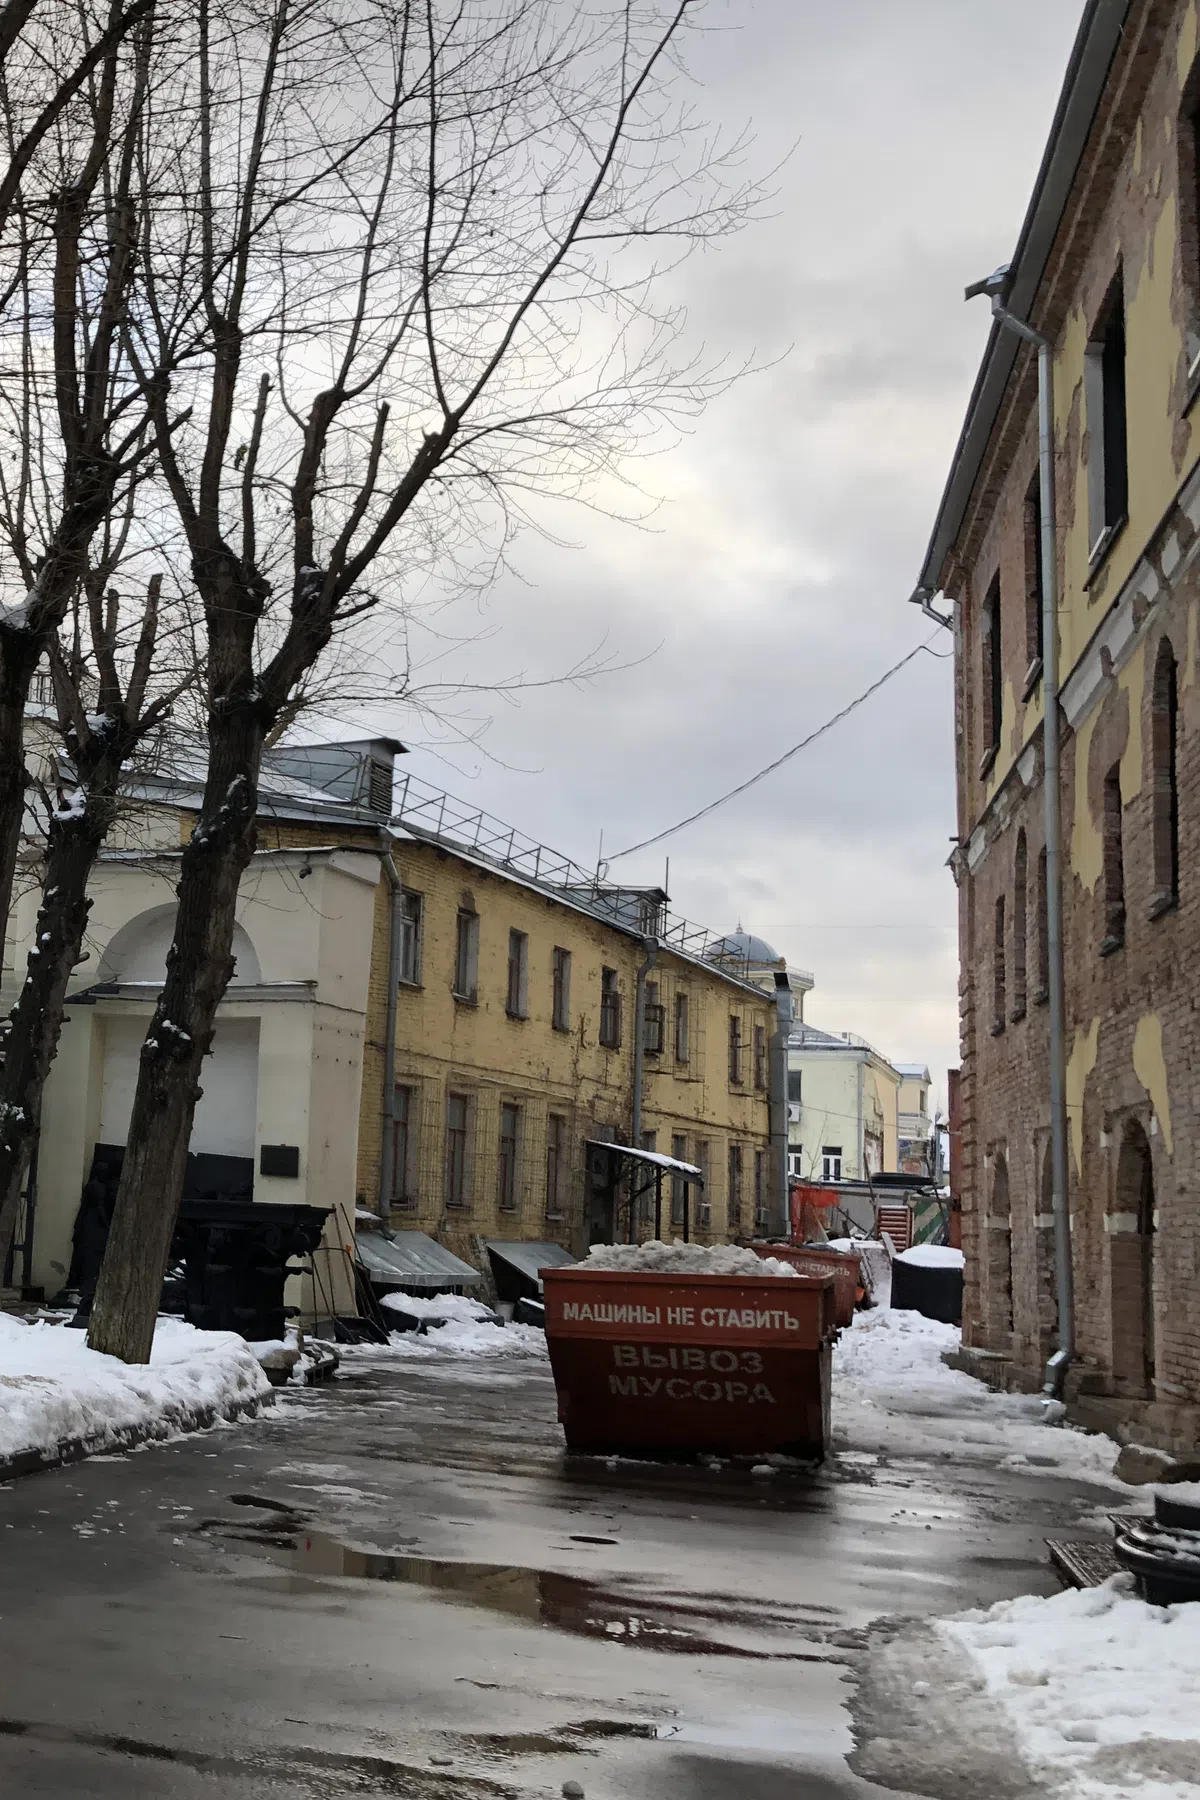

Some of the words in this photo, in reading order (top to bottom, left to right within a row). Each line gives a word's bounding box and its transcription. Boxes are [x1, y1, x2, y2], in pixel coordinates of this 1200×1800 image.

[810, 1263, 850, 1276] СТАВИТЬ
[563, 1302, 661, 1324] МАШИНЫ
[667, 1306, 695, 1326] НЕ
[700, 1307, 799, 1330] СТАВИТЬ
[613, 1345, 764, 1373] ВЫВОЗ
[608, 1374, 777, 1403] МУСОРА
